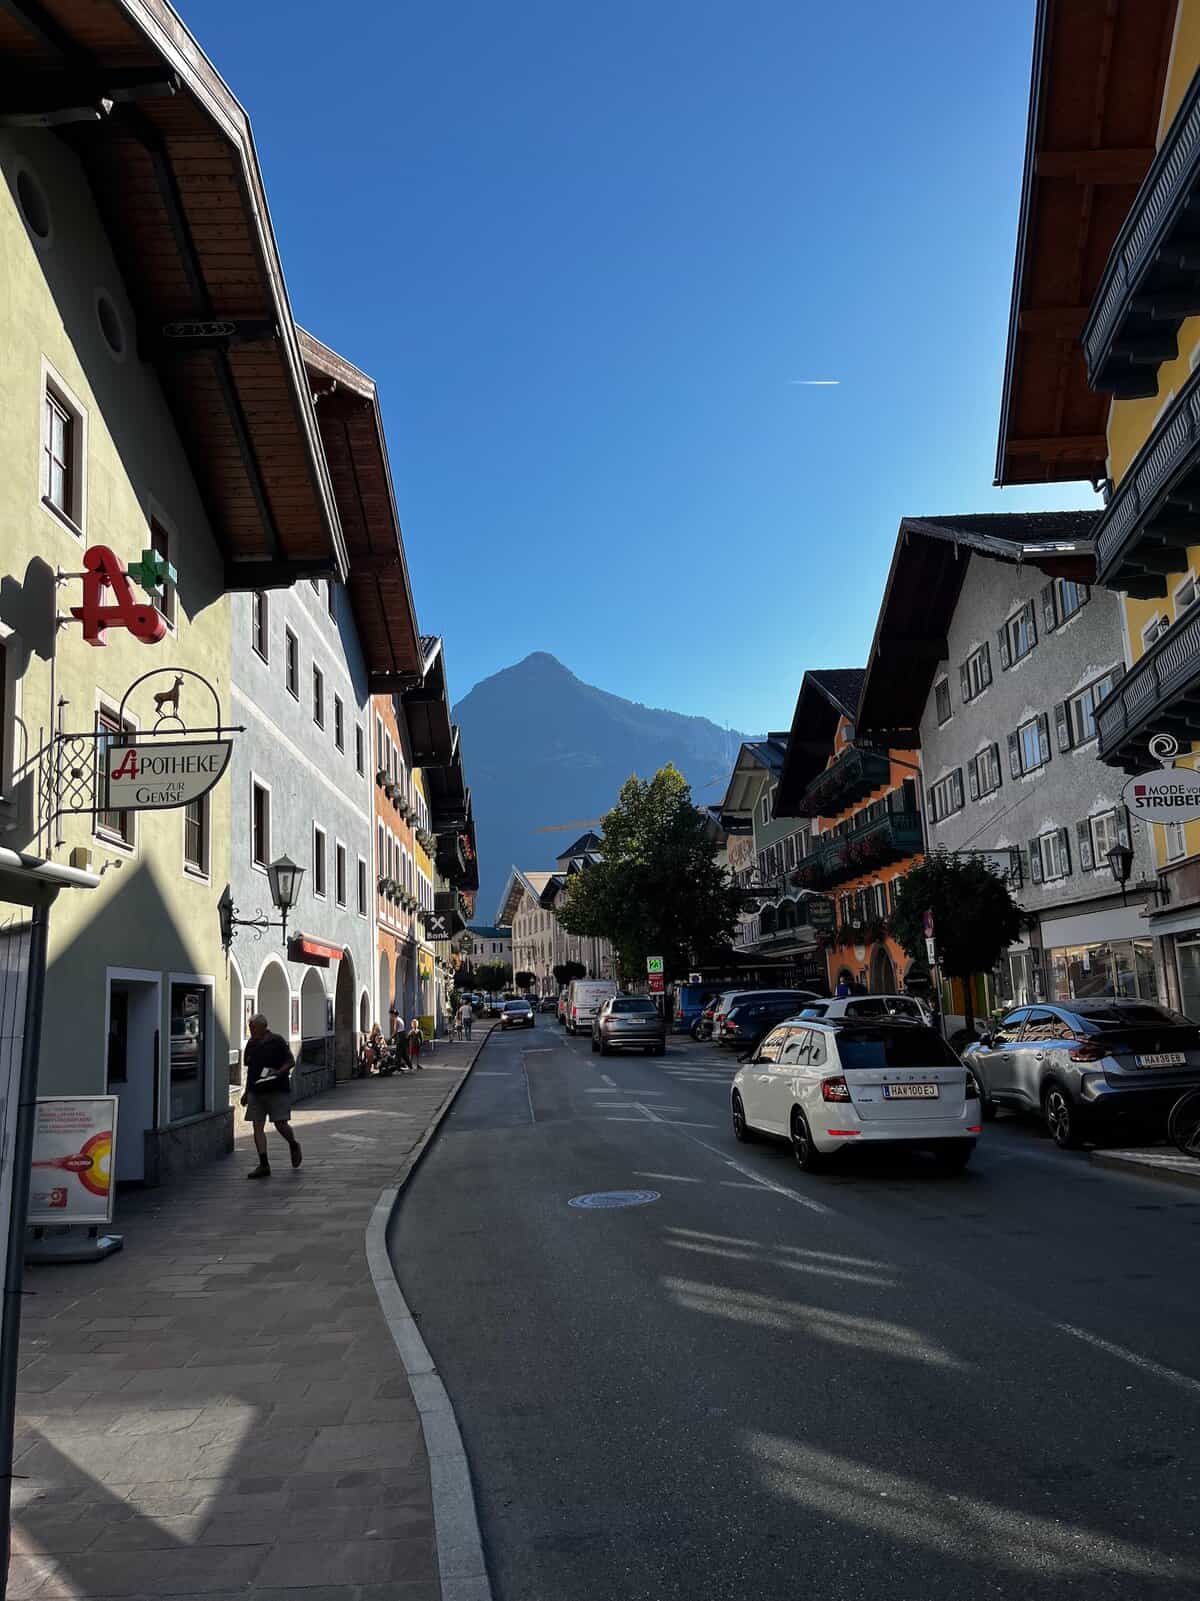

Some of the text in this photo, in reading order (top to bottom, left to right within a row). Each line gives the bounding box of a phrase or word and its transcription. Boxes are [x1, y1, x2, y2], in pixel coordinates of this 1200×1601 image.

[111, 749, 219, 780] APOTHEKE
[1149, 785, 1185, 795] MODE
[426, 930, 449, 940] Bank
